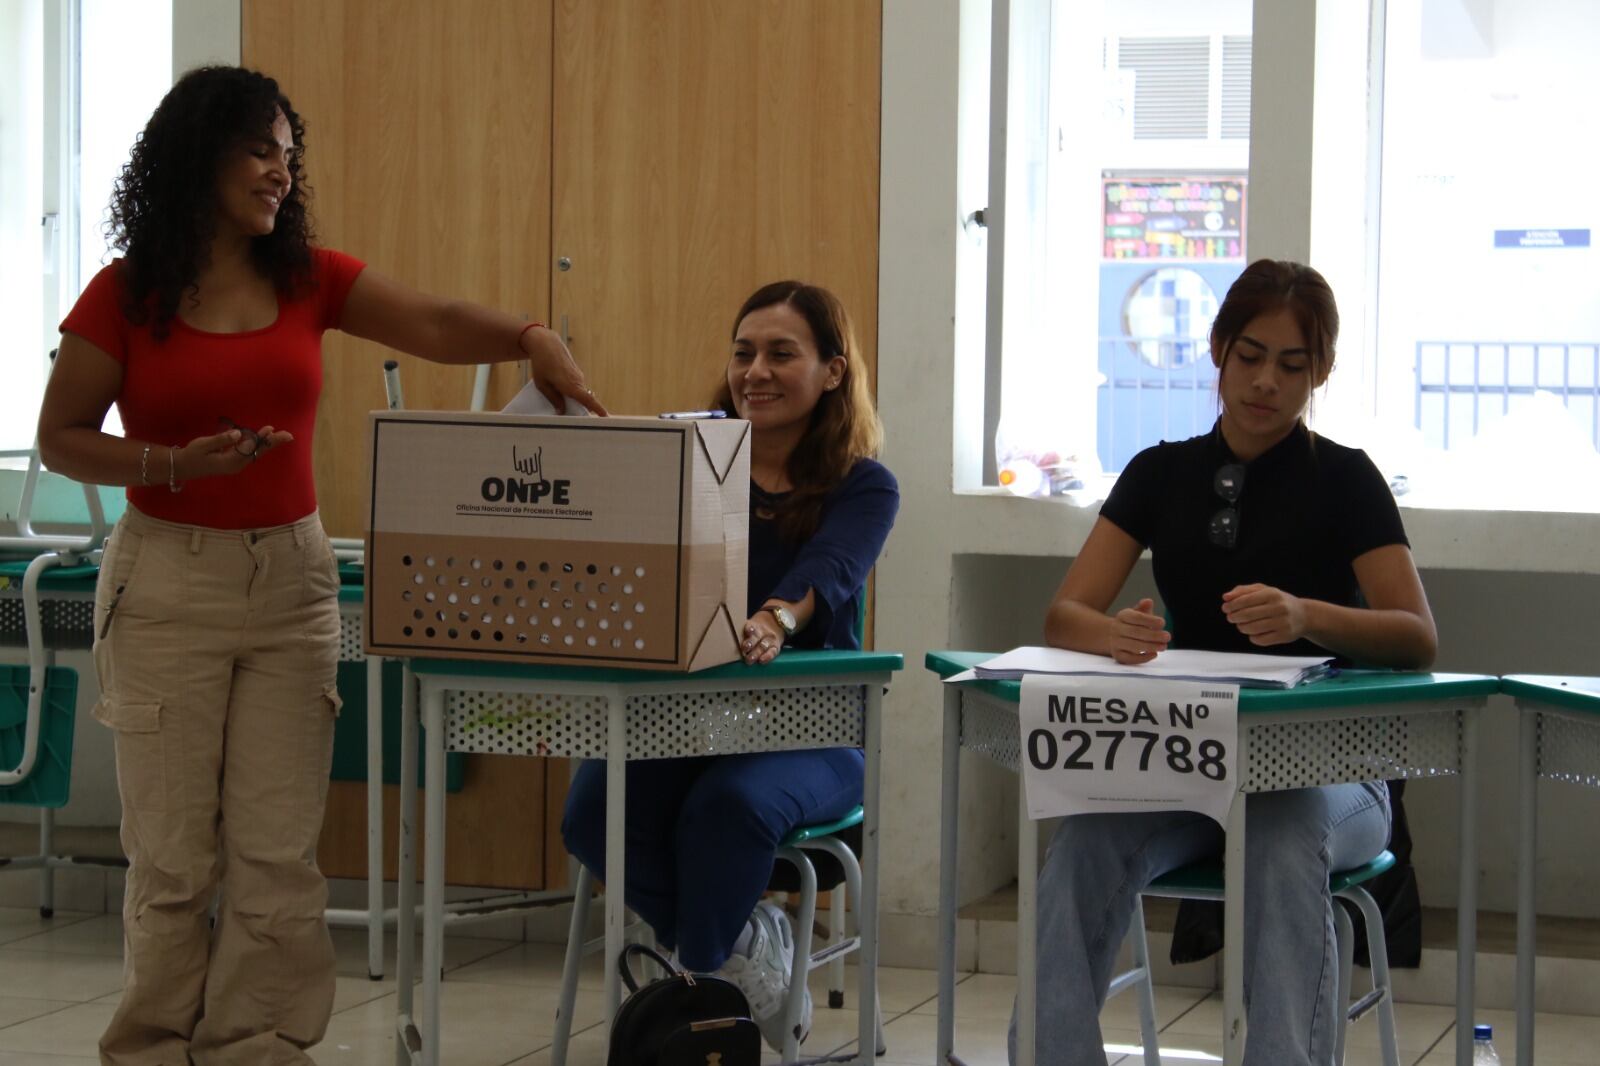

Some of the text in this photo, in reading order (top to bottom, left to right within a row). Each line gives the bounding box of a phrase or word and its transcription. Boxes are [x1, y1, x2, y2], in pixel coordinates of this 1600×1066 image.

[481, 477, 570, 505] ONPE
[456, 504, 593, 516] Oficina Nacional de Procesos Electorales
[1048, 694, 1159, 725] MESA
[1027, 728, 1227, 781] 027788
